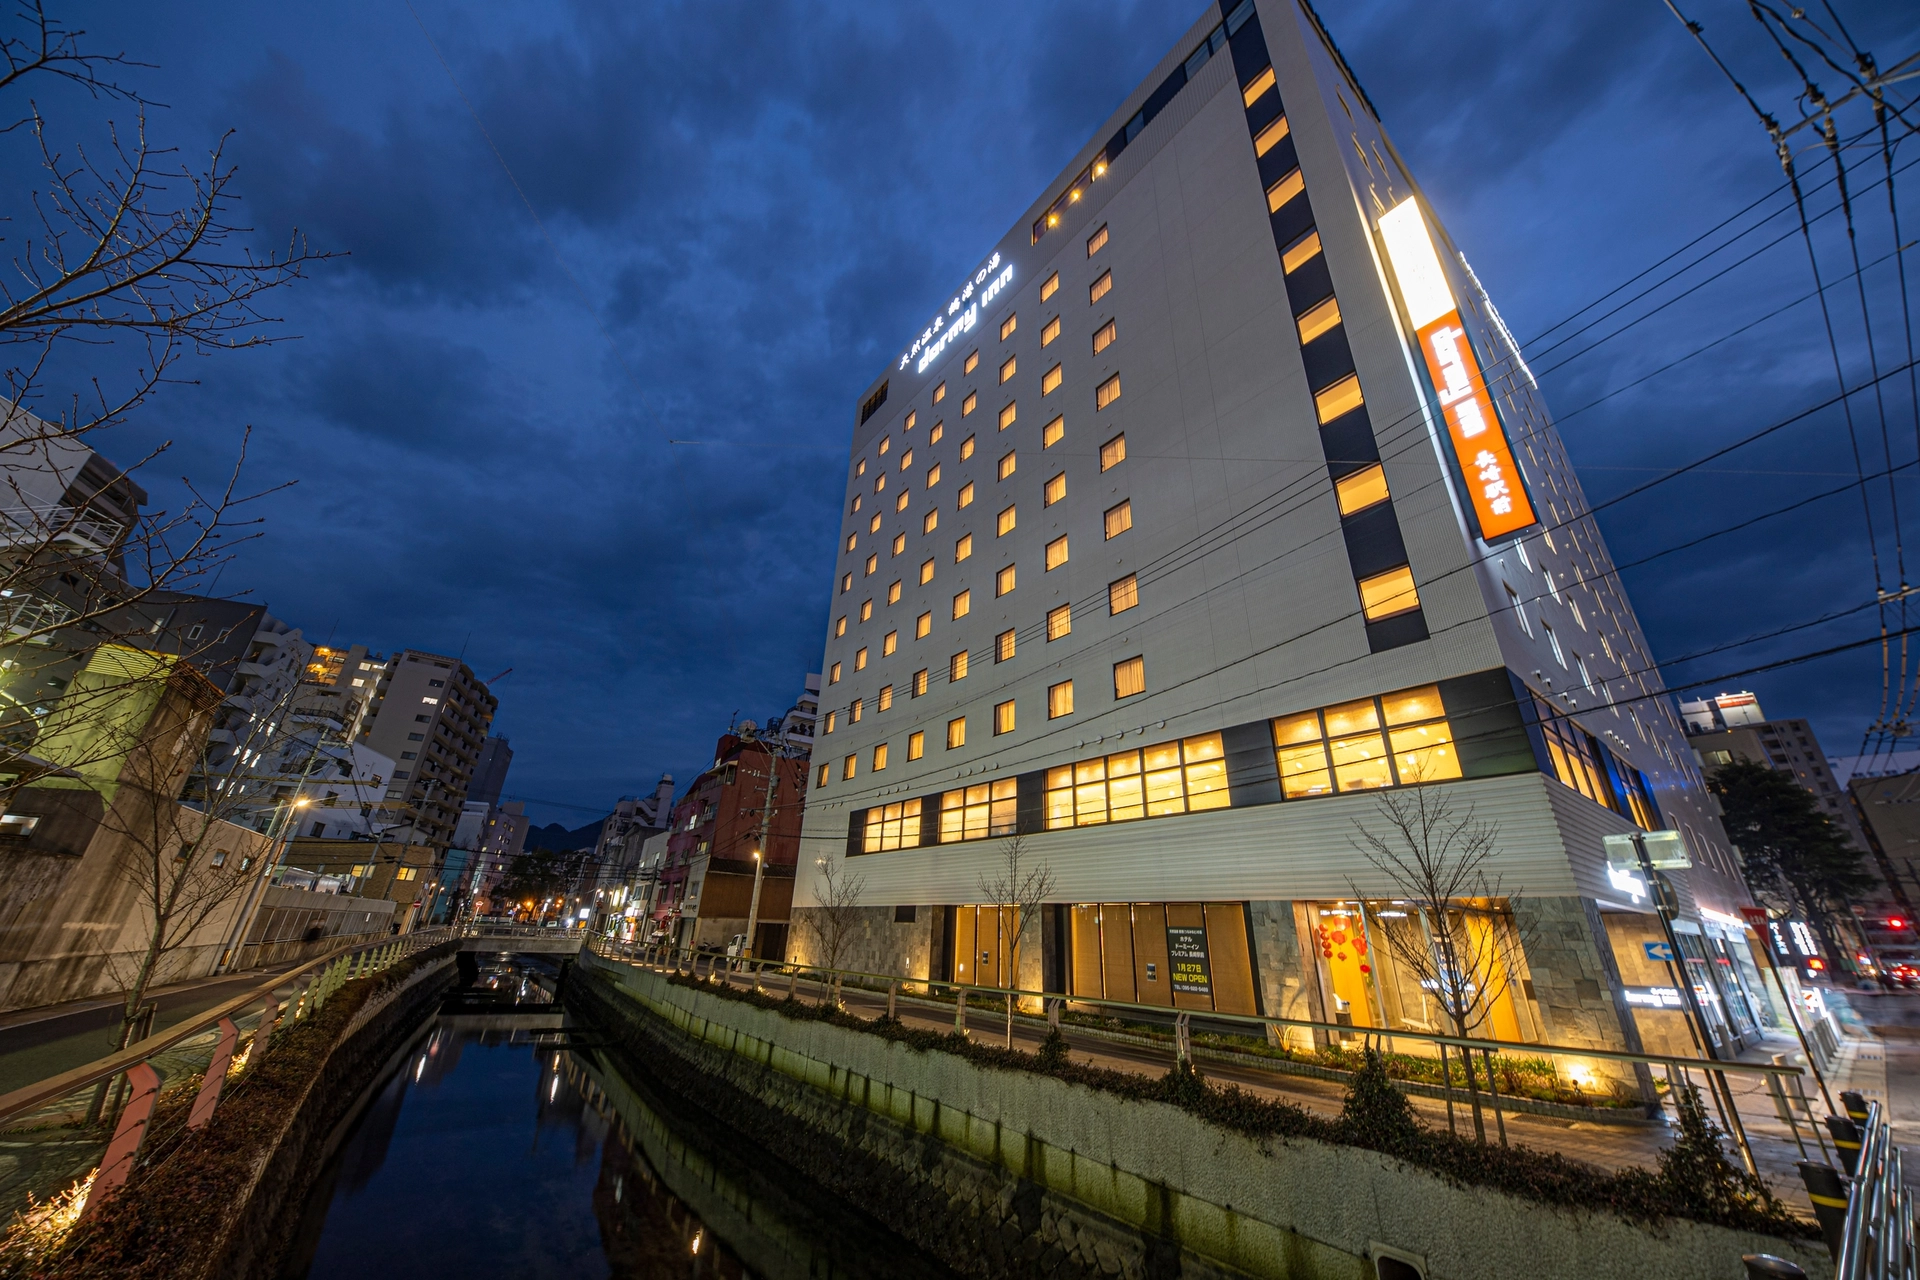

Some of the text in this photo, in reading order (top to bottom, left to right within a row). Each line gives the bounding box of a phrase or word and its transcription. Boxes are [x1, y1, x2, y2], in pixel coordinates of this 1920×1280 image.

[918, 264, 1013, 374] dormy inn
[1177, 963, 1202, 973] 1月27日
[1173, 973, 1208, 983] NEW OPEN
